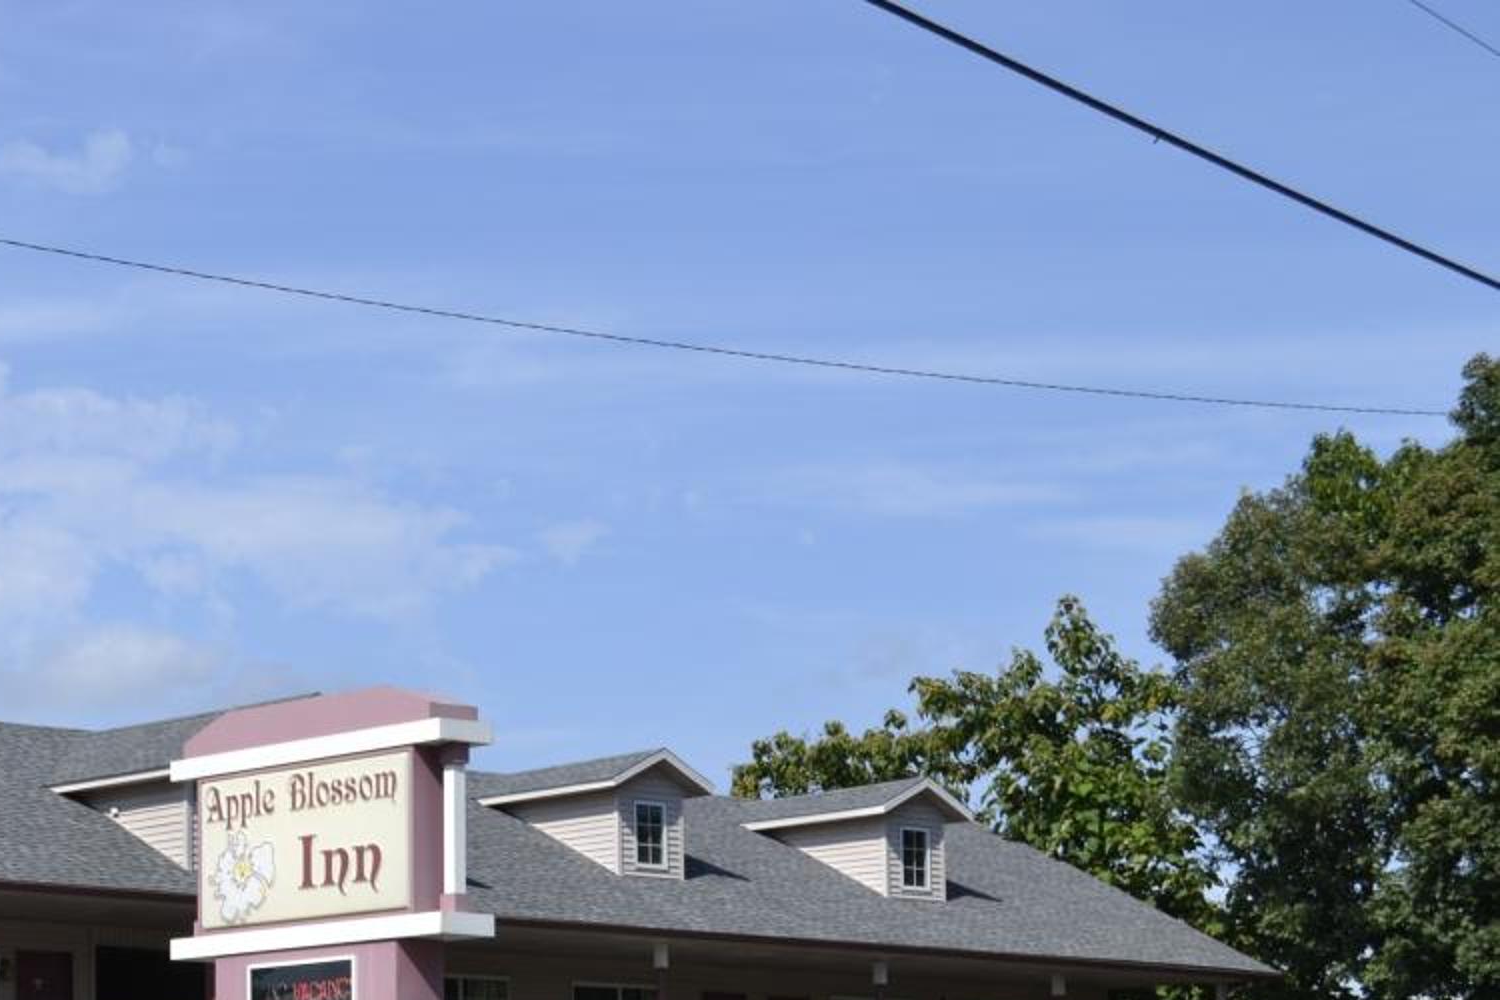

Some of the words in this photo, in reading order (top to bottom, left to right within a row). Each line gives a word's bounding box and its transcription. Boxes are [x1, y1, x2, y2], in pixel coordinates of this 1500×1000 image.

[206, 780, 275, 830] Apple
[289, 767, 398, 812] Blossom
[298, 834, 382, 896] Inn
